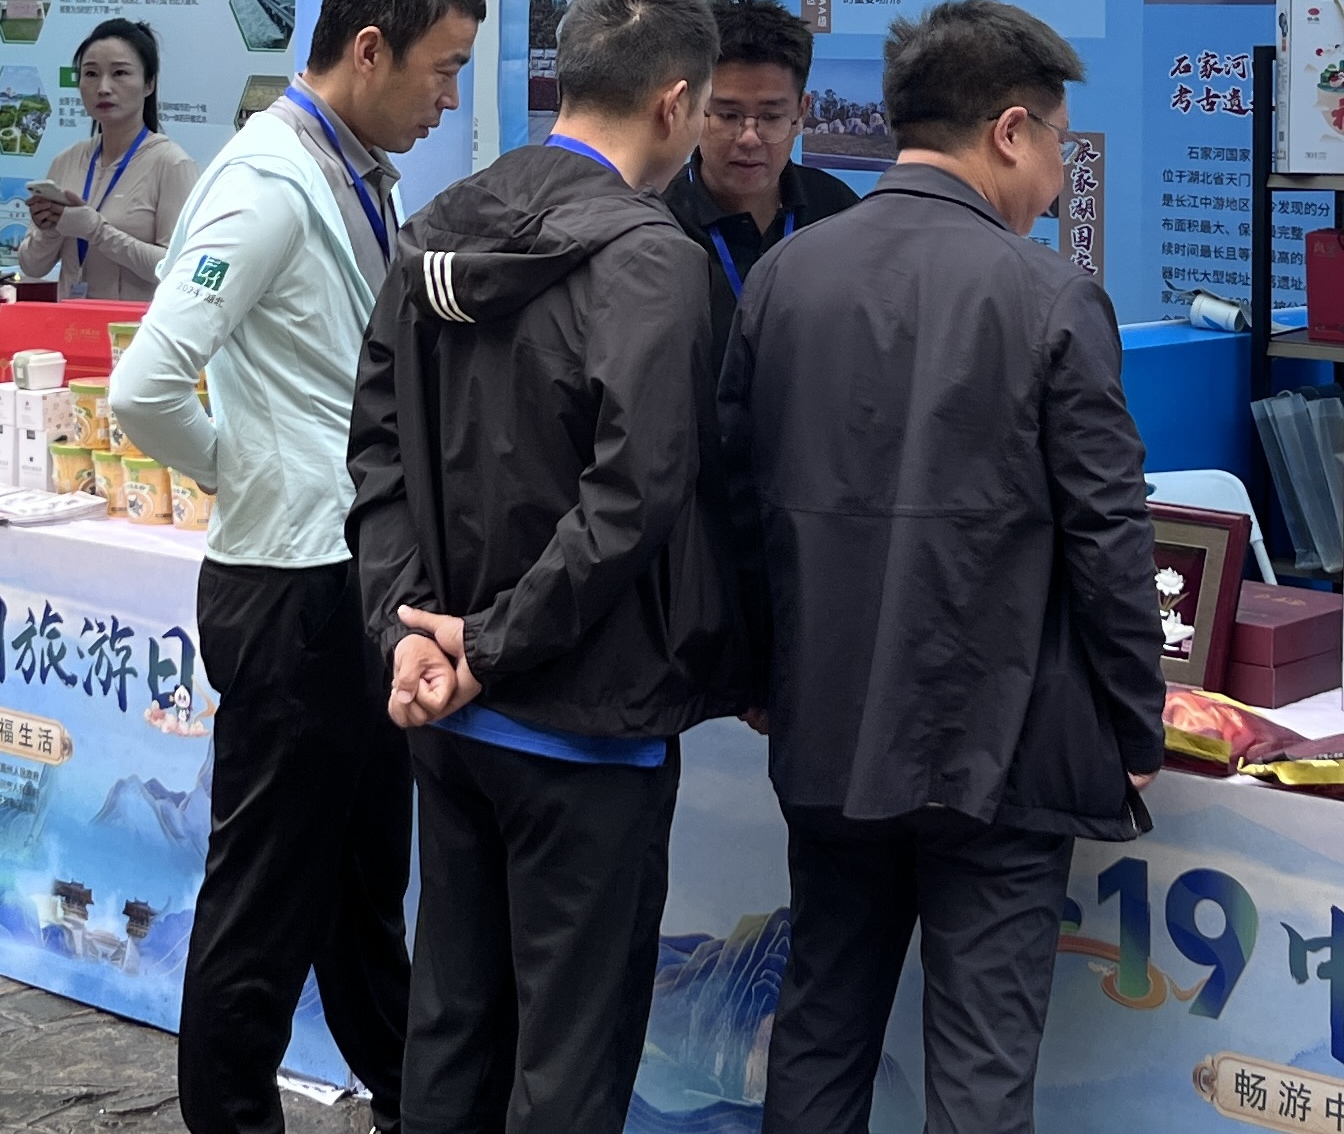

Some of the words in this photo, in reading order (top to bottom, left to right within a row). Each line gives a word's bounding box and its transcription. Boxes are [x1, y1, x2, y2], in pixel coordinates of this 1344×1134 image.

[1168, 51, 1254, 81] 石家河
[1187, 146, 1251, 163] 石家河国家
[1162, 169, 1251, 188] 位于湖北省天门
[1162, 193, 1331, 217] 是长江中游地区发现的分
